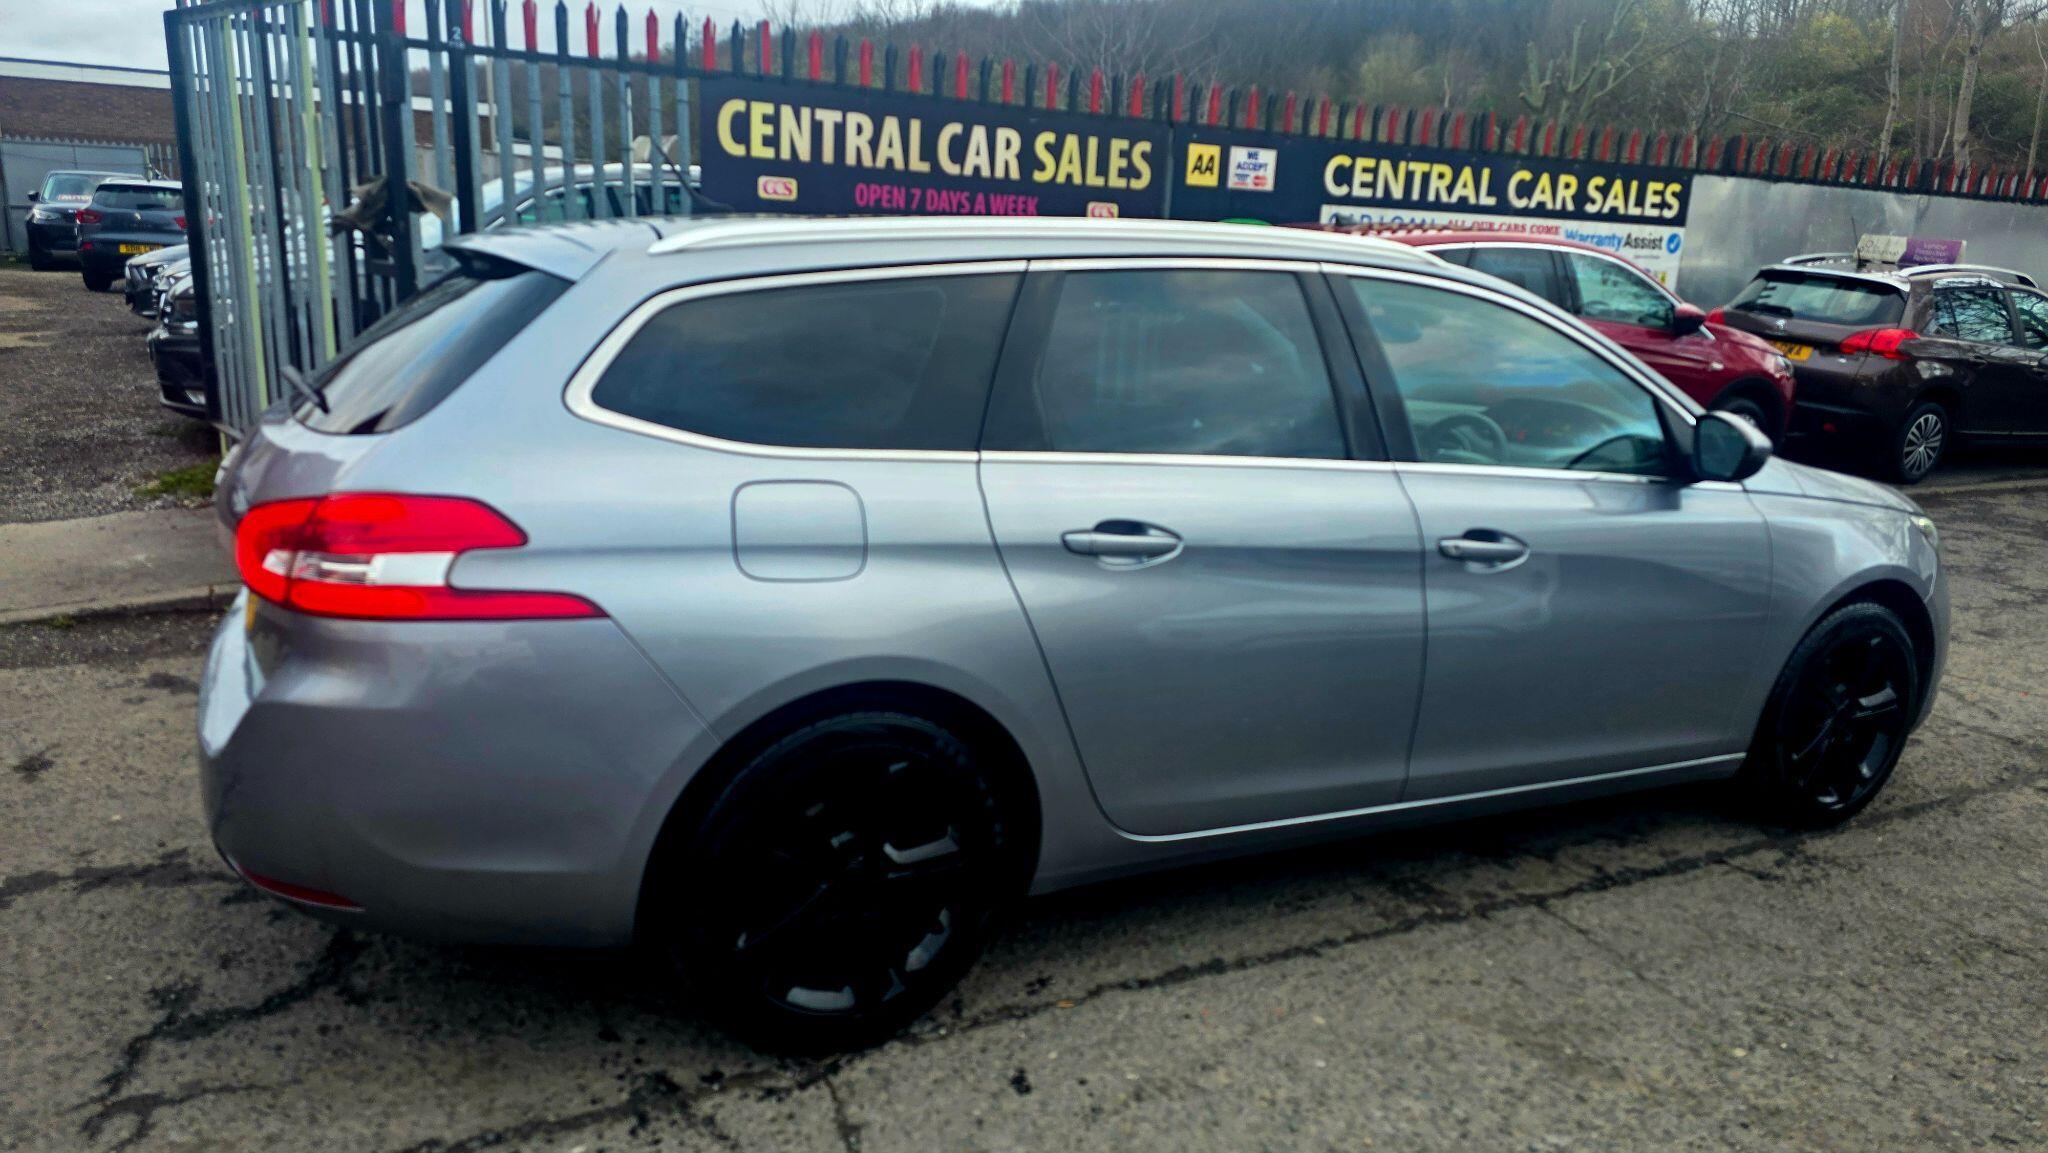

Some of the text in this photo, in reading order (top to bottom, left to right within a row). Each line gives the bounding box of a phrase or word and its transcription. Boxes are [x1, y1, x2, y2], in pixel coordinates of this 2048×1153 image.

[717, 98, 1153, 190] CENTRAL CAR SALES
[1191, 153, 1216, 176] AA
[855, 182, 1039, 217] OPEN 7 DAYS A WEEK
[1323, 153, 1682, 220] CENTRAL CAR SALES
